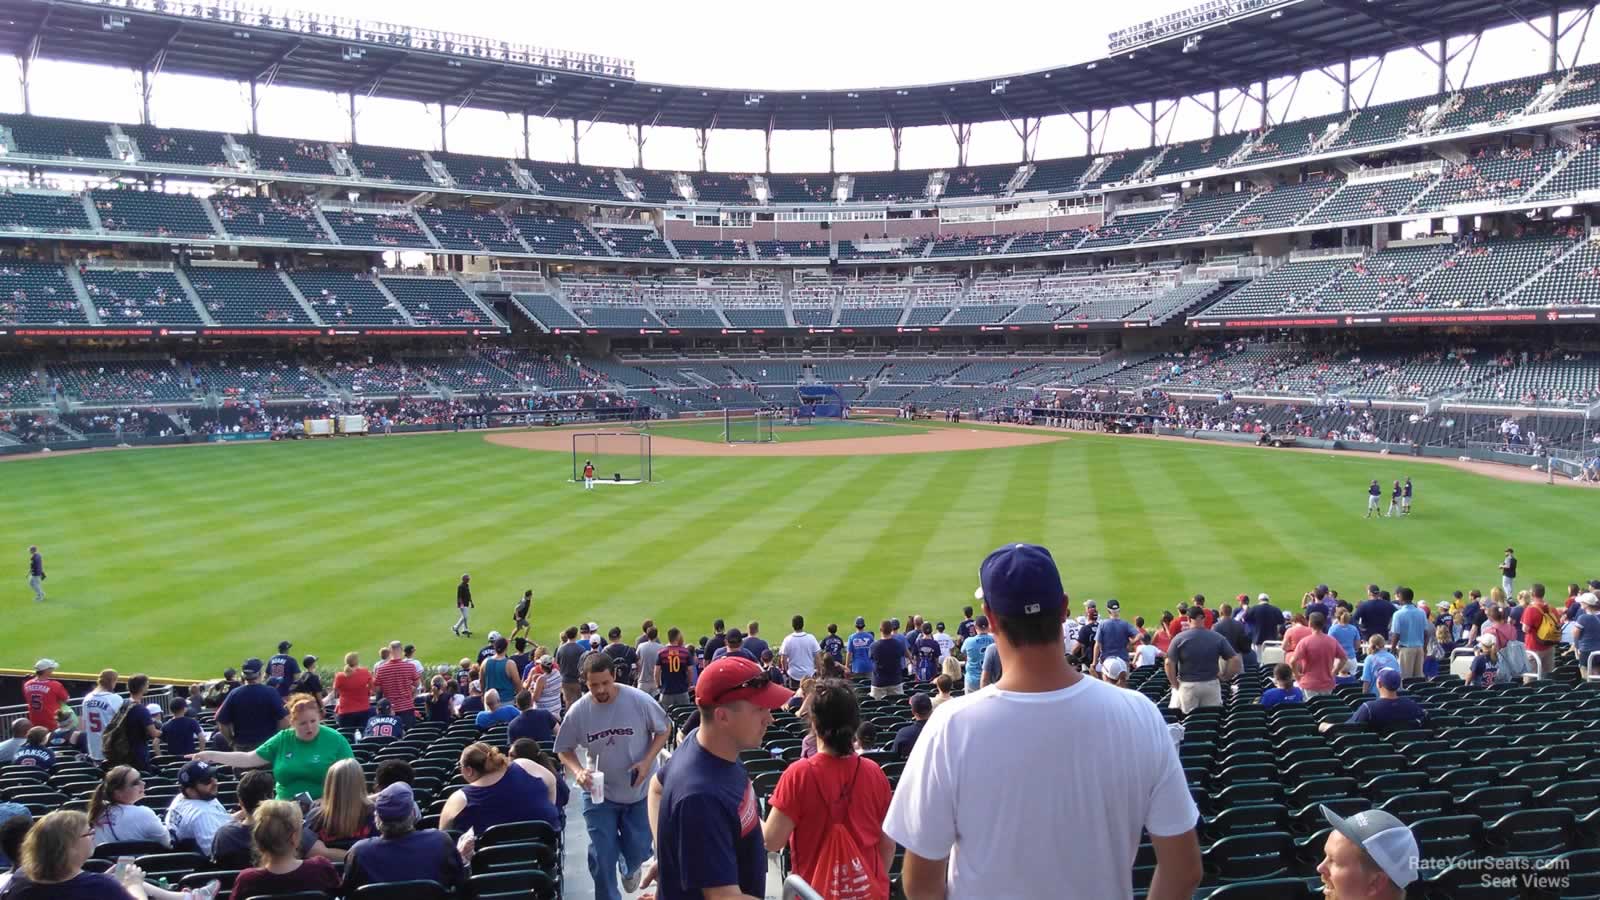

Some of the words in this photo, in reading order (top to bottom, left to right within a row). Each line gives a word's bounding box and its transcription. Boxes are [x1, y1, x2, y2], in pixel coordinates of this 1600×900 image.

[668, 656, 680, 672] 10
[88, 712, 102, 732] 5
[587, 728, 633, 743] braves
